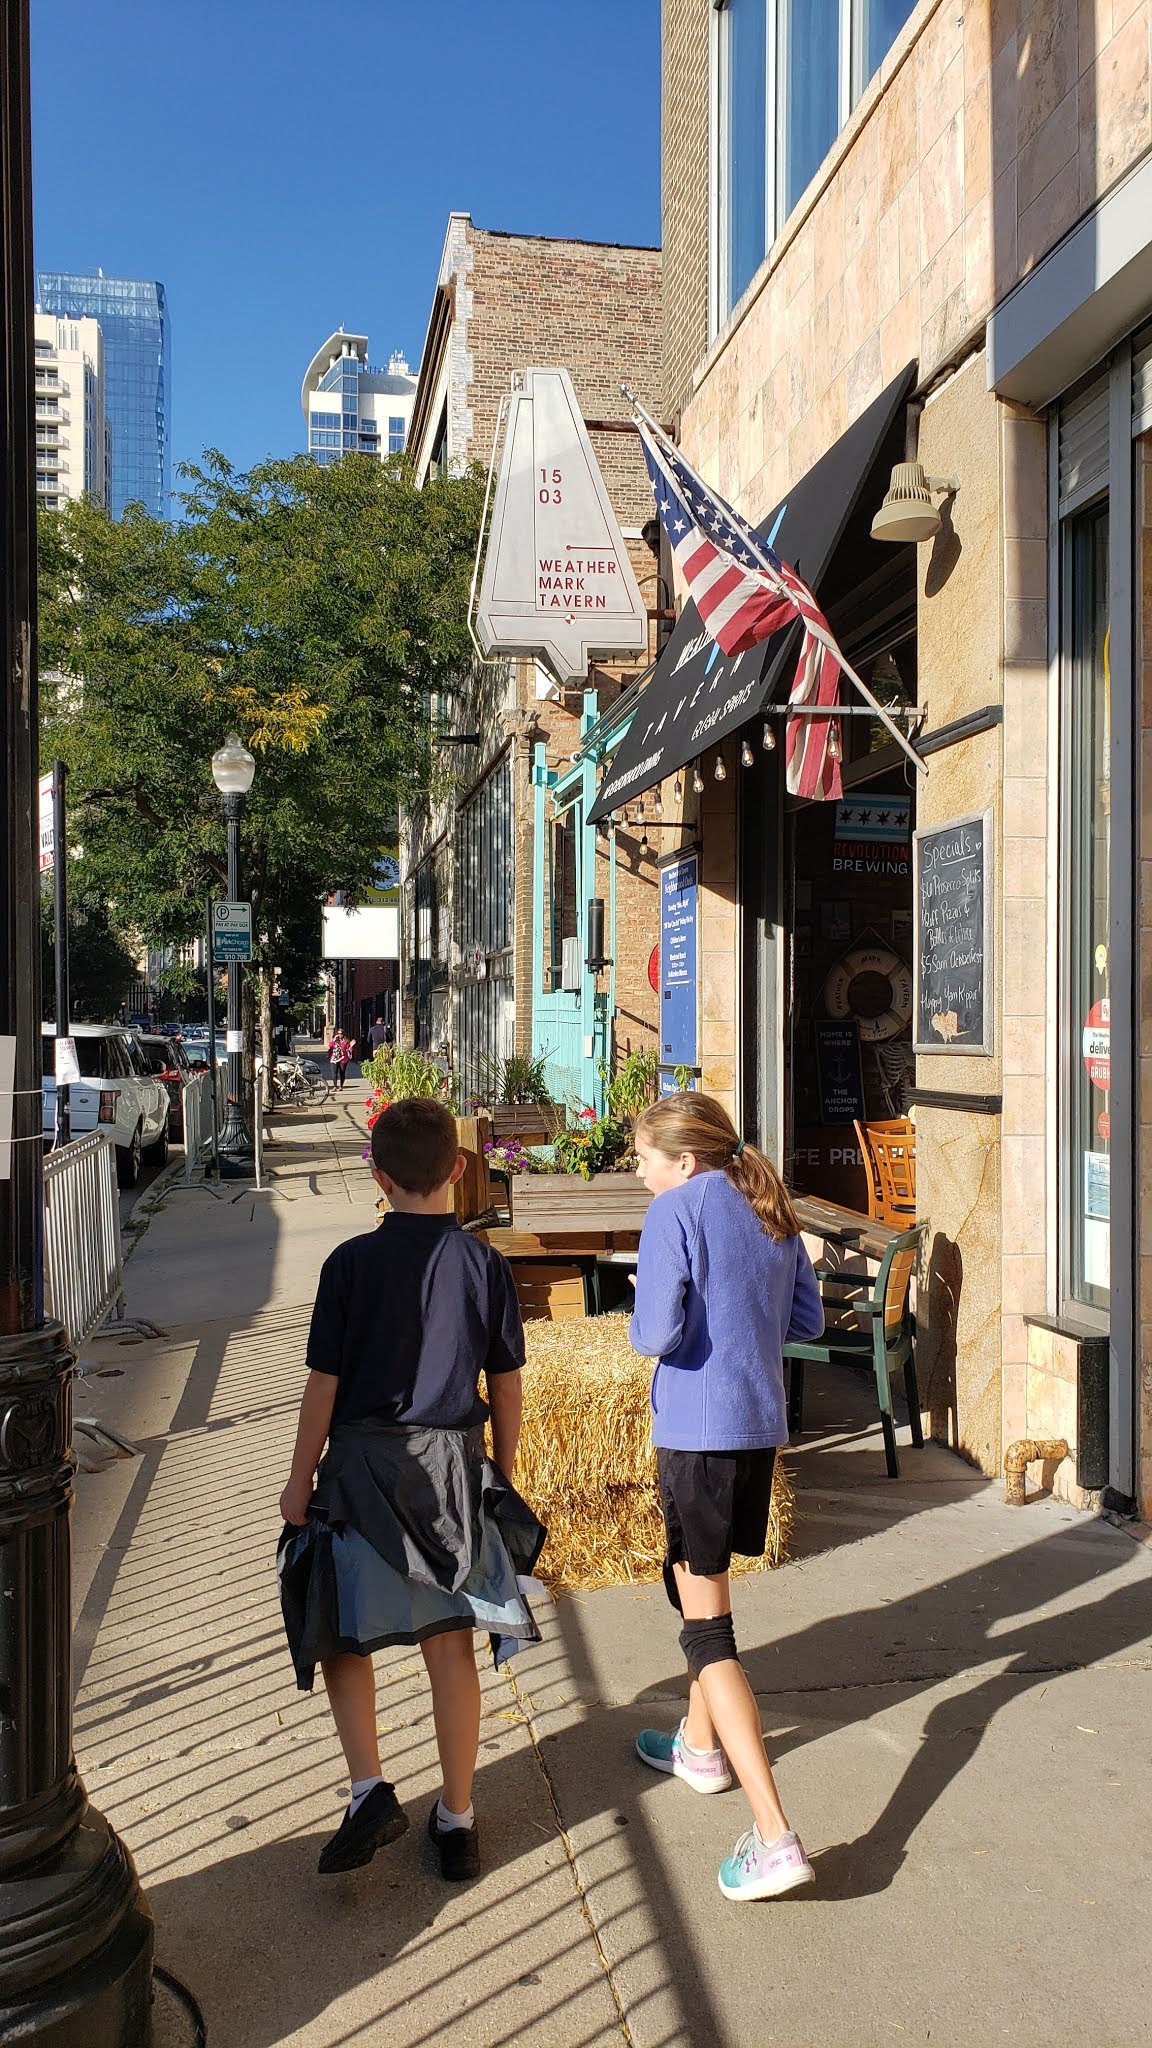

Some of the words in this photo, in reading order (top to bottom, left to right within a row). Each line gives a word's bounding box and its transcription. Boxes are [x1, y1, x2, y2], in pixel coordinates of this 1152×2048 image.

[540, 468, 562, 484] 15
[539, 488, 562, 504] 03
[539, 559, 616, 574] WEATHER
[539, 577, 585, 591] MARK
[540, 594, 606, 608] TAVERN
[642, 650, 746, 746] TAVERN
[41, 829, 54, 848] VALE
[833, 842, 909, 861] REVOLUTION
[923, 831, 970, 868] Specials
[832, 858, 908, 875] BREWING
[932, 875, 960, 895] Prosecco
[861, 955, 881, 964] MARK
[921, 952, 932, 980] $5
[899, 977, 910, 1009] TAVERN
[1090, 1041, 1111, 1055] delive
[1090, 1065, 1110, 1080] GRUBH
[833, 1088, 848, 1096] THE
[824, 1097, 858, 1105] ANCHOR
[795, 1147, 820, 1165] FE
[829, 1147, 864, 1166] PRE
[769, 1854, 793, 1868] UNDR
